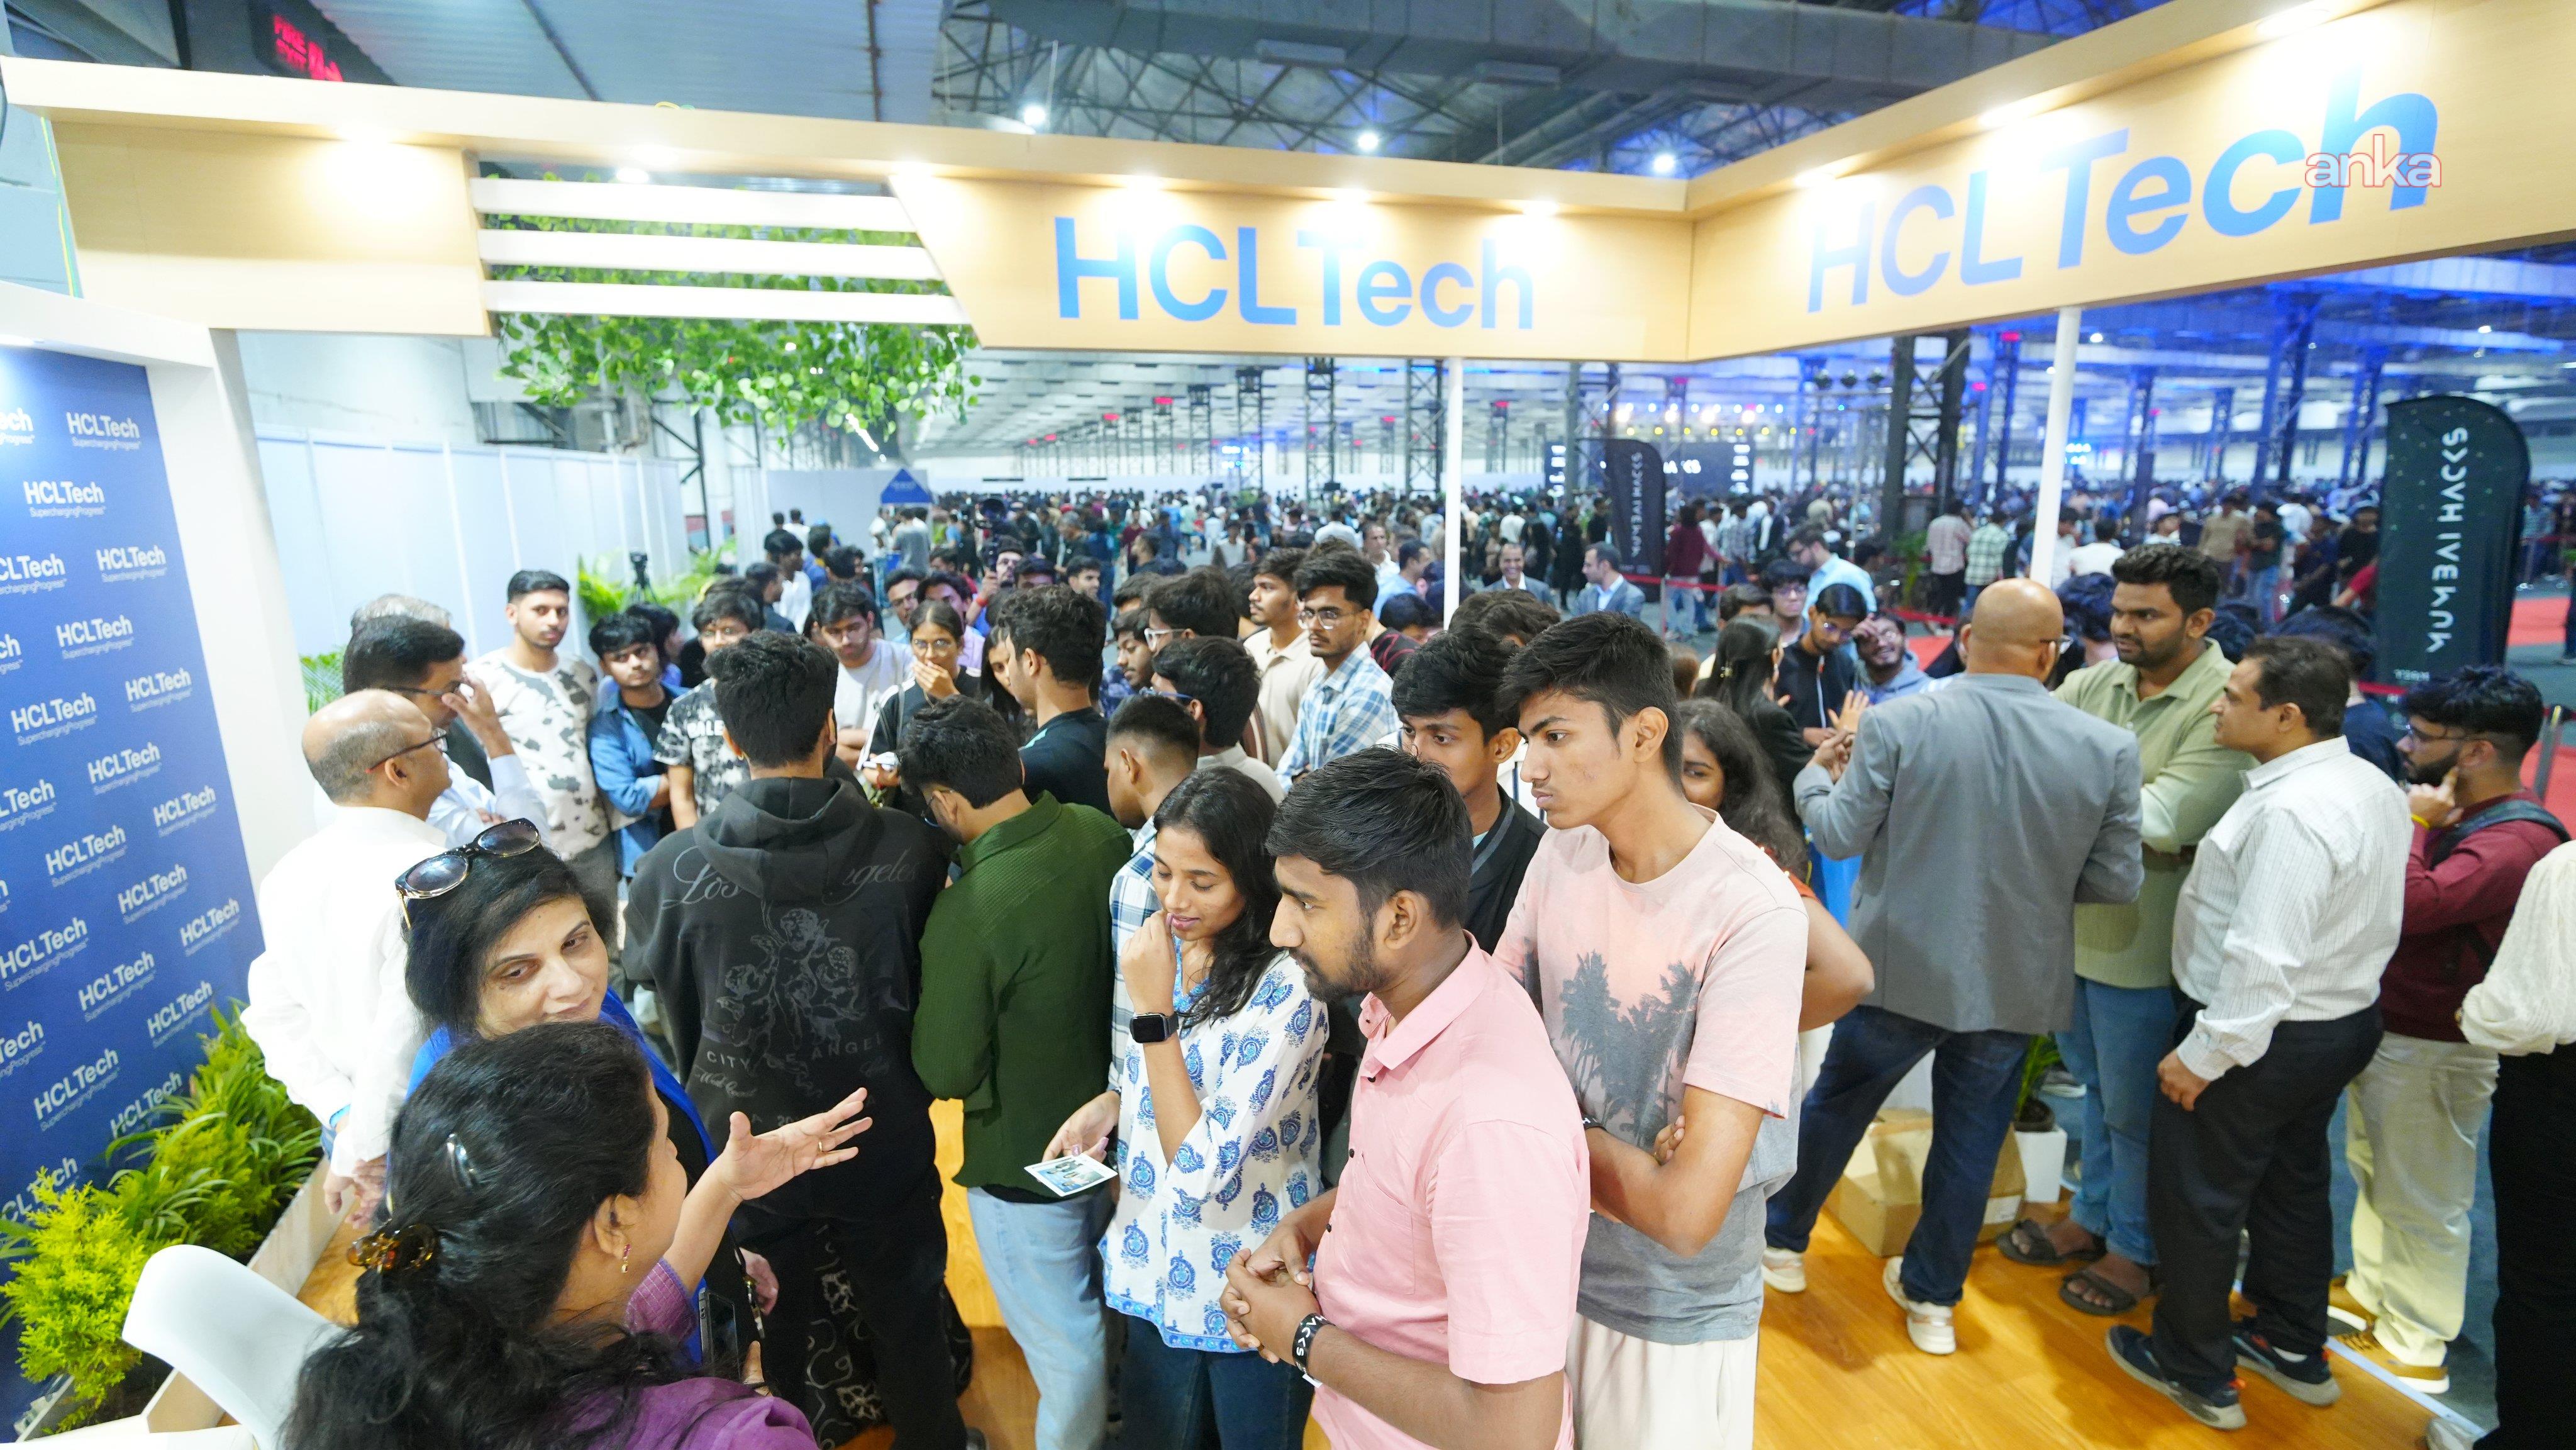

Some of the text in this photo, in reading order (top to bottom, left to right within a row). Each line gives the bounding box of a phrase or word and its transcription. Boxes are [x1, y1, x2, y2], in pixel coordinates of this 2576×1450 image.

[1806, 62, 2438, 313] HCLTech
[1054, 216, 1533, 330] HCLTech
[66, 411, 140, 439] HCLTech
[23, 481, 104, 504] HCLTech
[96, 545, 166, 571] HCLTech
[56, 615, 133, 647] HCLTech
[125, 667, 191, 701] HCLTech
[11, 693, 96, 733] HCLTech
[87, 742, 161, 784] HCLTech
[153, 785, 216, 827] HCLTech
[45, 825, 126, 876] HCLTech
[118, 864, 187, 914] HCLTech
[180, 898, 240, 946] HCLTech
[0, 917, 88, 979] HCLTech
[78, 952, 155, 1012] HCLTech
[147, 981, 213, 1038] HCLTech
[33, 1048, 119, 1120] HCLTech
